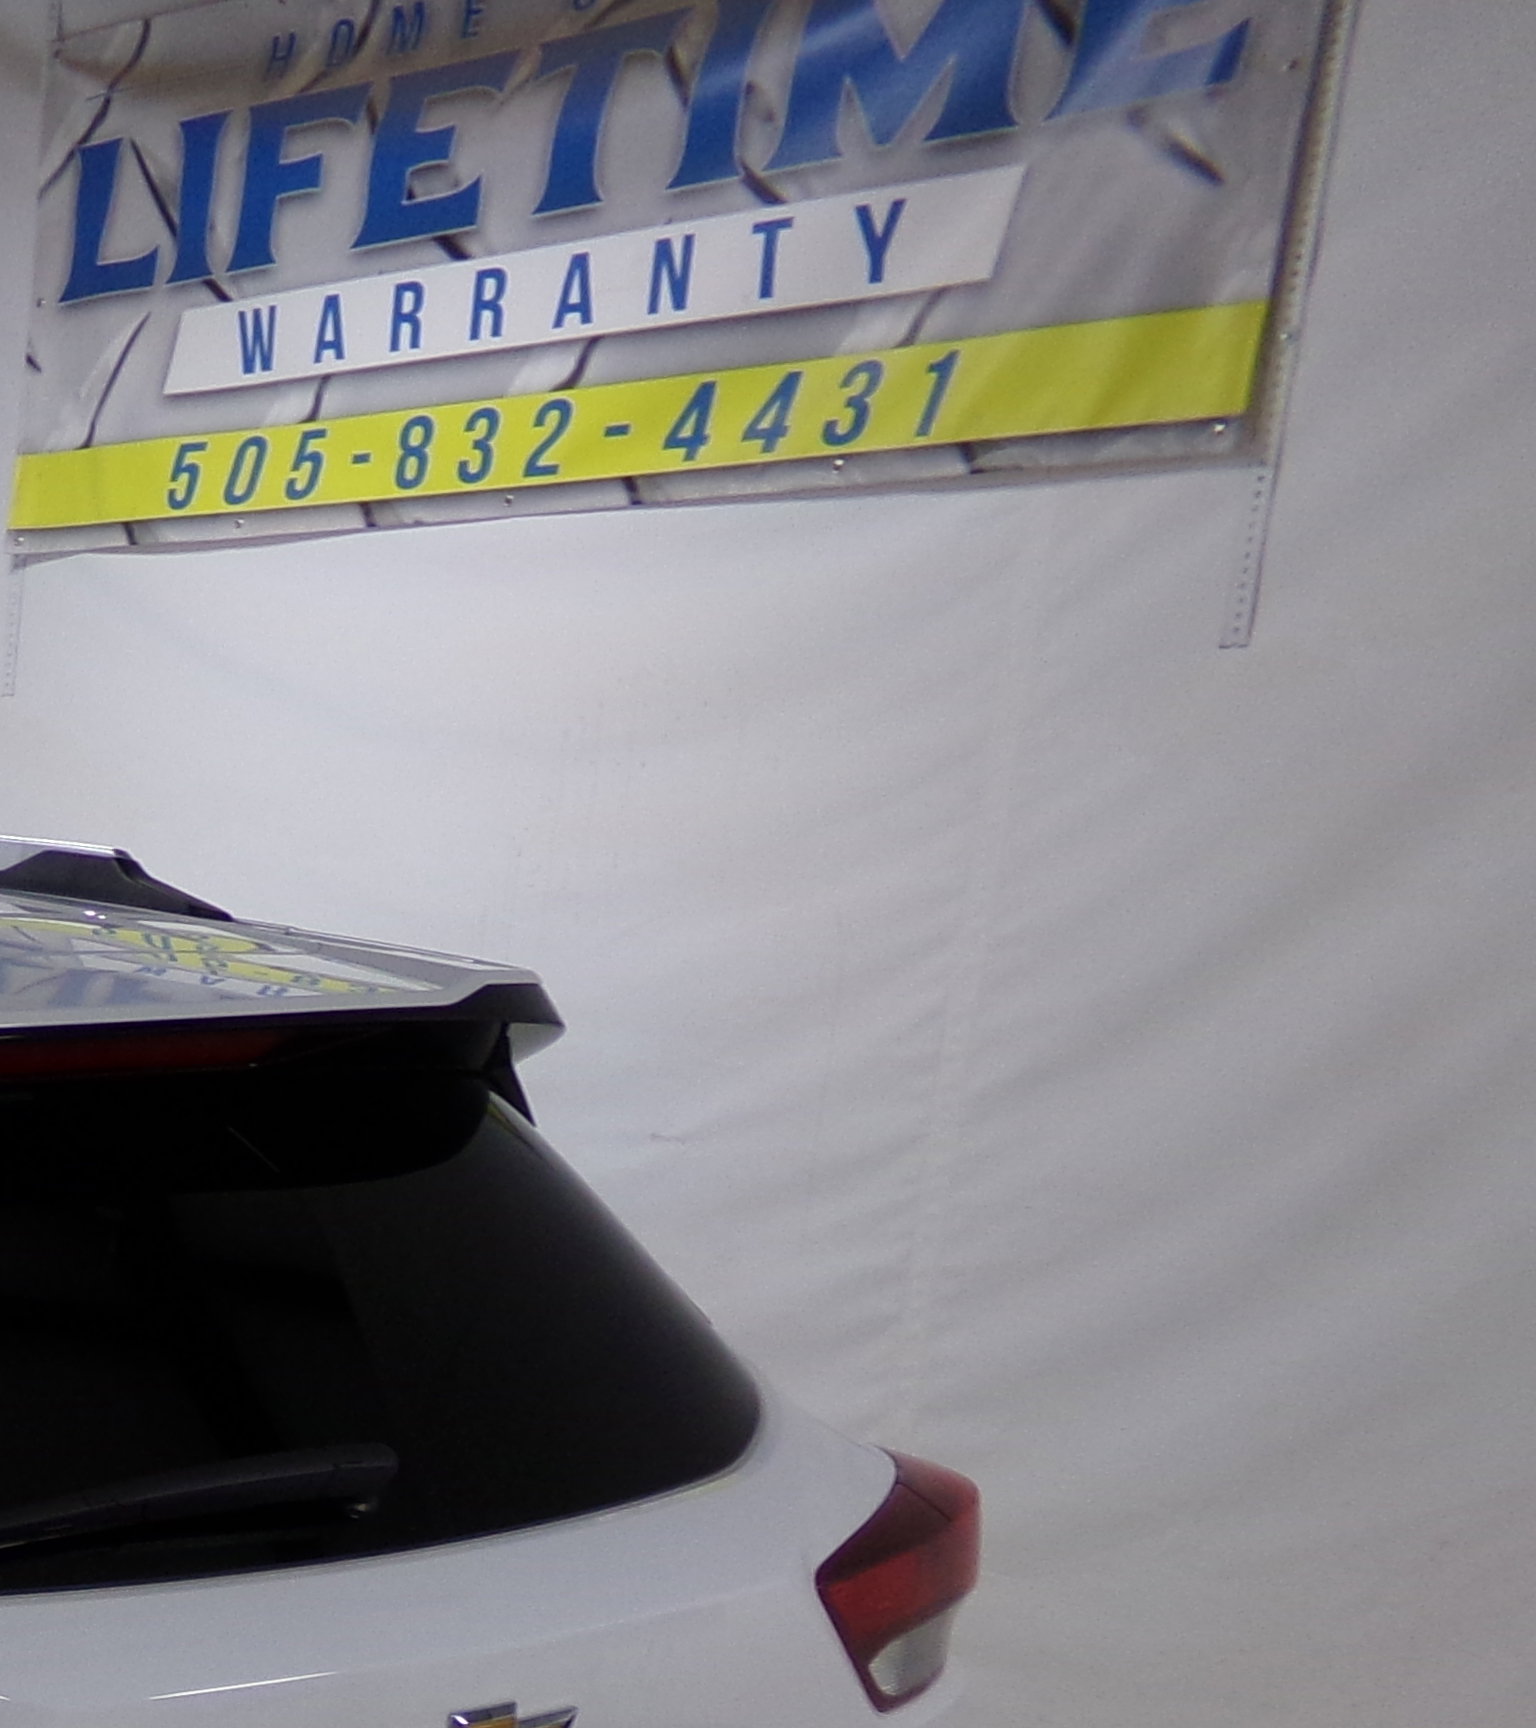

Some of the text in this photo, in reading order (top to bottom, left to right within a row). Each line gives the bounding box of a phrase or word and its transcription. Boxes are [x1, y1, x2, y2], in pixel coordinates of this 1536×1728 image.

[266, 0, 485, 78] HOME
[58, 0, 1251, 305] LIFETIME
[237, 198, 907, 376] WARRANTY
[166, 349, 962, 511] 505-832-4431
